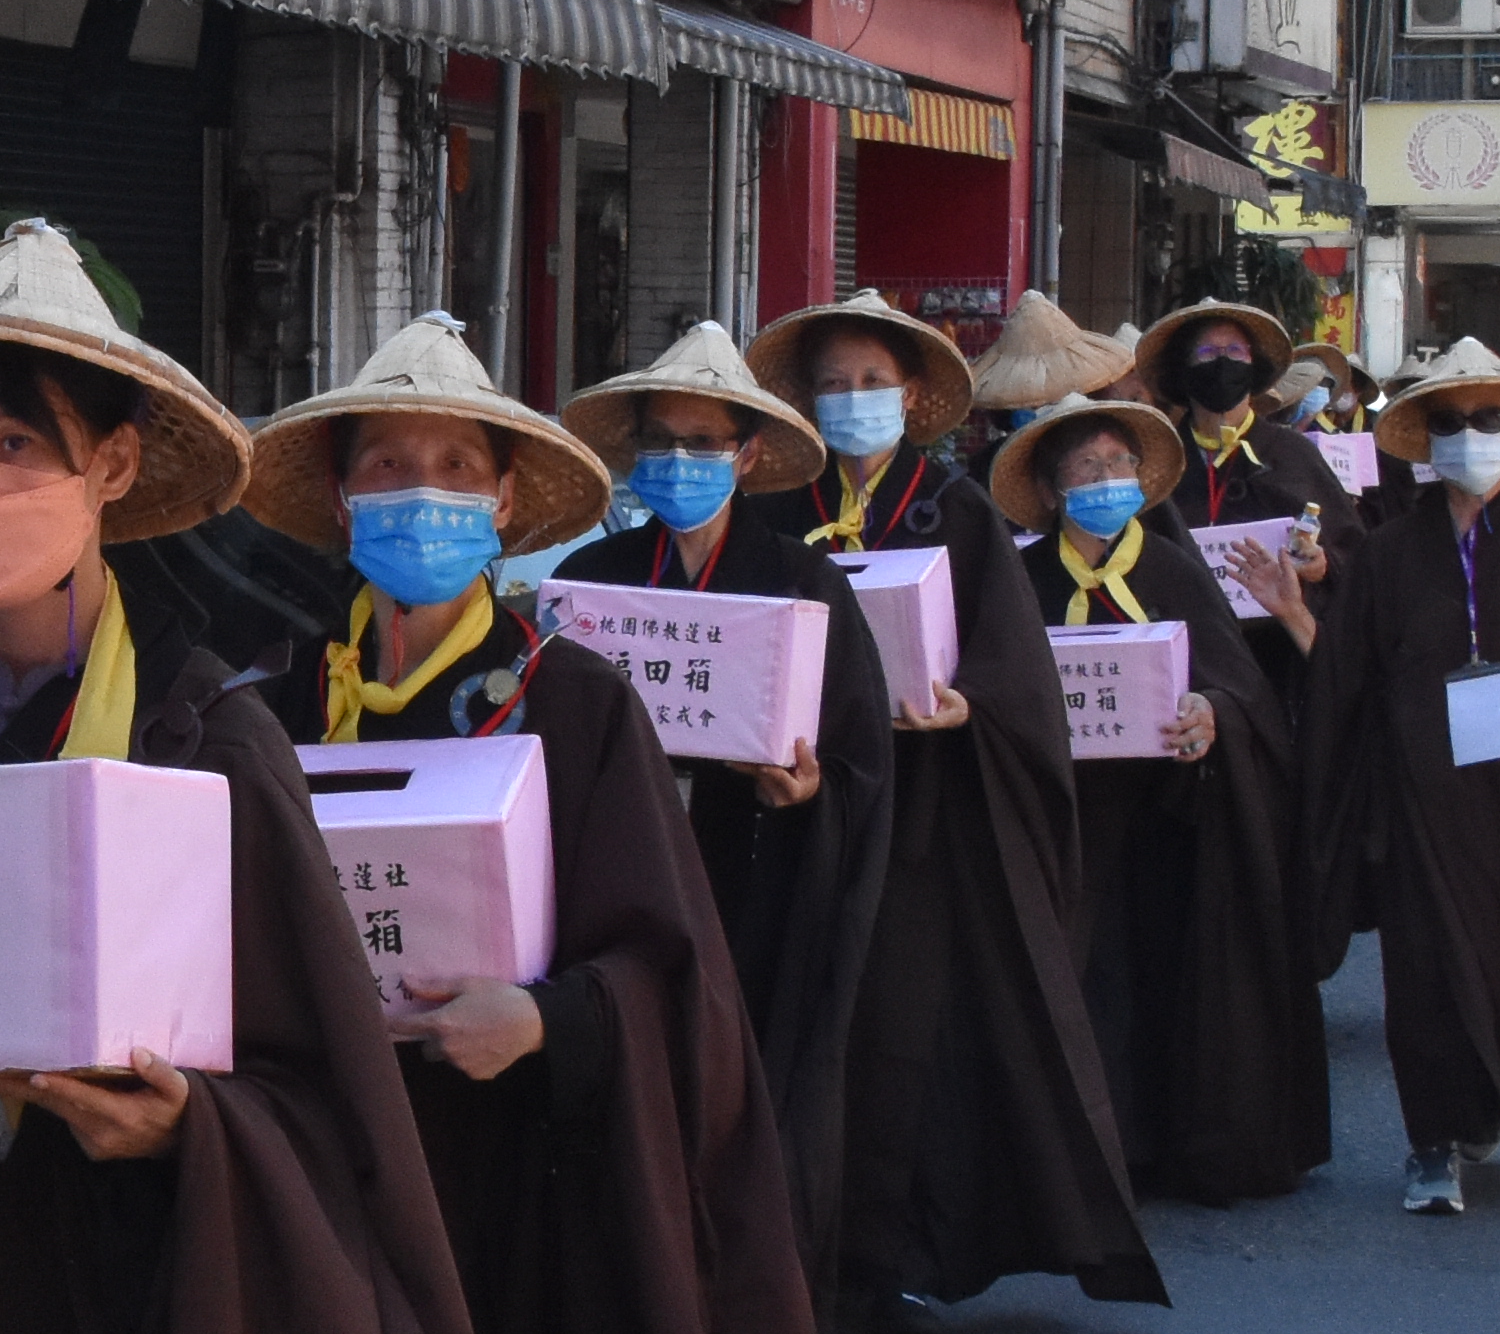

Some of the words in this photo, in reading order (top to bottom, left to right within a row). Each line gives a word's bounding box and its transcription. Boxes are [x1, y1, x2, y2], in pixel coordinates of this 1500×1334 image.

[599, 615, 723, 645] 桃園佛教蓮社
